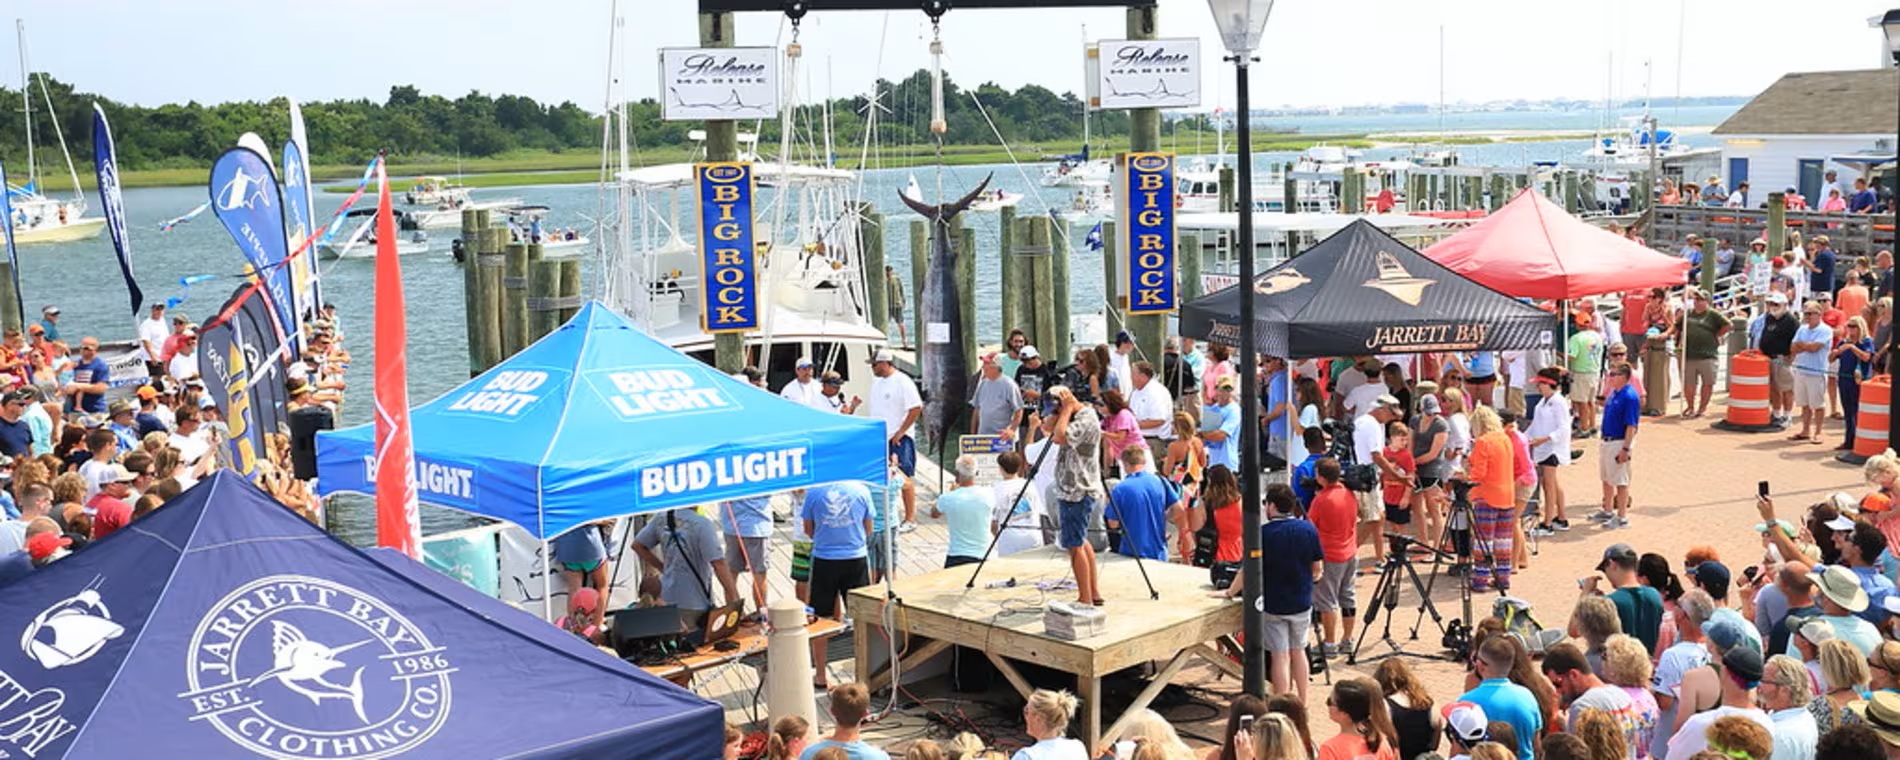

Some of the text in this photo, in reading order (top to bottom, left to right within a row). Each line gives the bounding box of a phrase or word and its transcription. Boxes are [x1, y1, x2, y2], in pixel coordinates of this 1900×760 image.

[678, 54, 765, 77] Release
[1112, 46, 1189, 68] Release
[1138, 174, 1164, 226] BIG
[712, 185, 748, 323] BIG ROCK
[1138, 234, 1166, 305] ROCK
[1366, 323, 1489, 348] JARRETT BAY
[482, 370, 549, 393] BUD
[609, 370, 696, 394] BUD
[448, 391, 540, 415] LIGHT
[610, 388, 729, 416] LIGHT
[642, 461, 712, 497] BUD
[200, 583, 417, 675] JARRETT BAY
[392, 654, 449, 674] 1986
[191, 687, 251, 713] EST.
[238, 683, 438, 757] CLOTHING CO.
